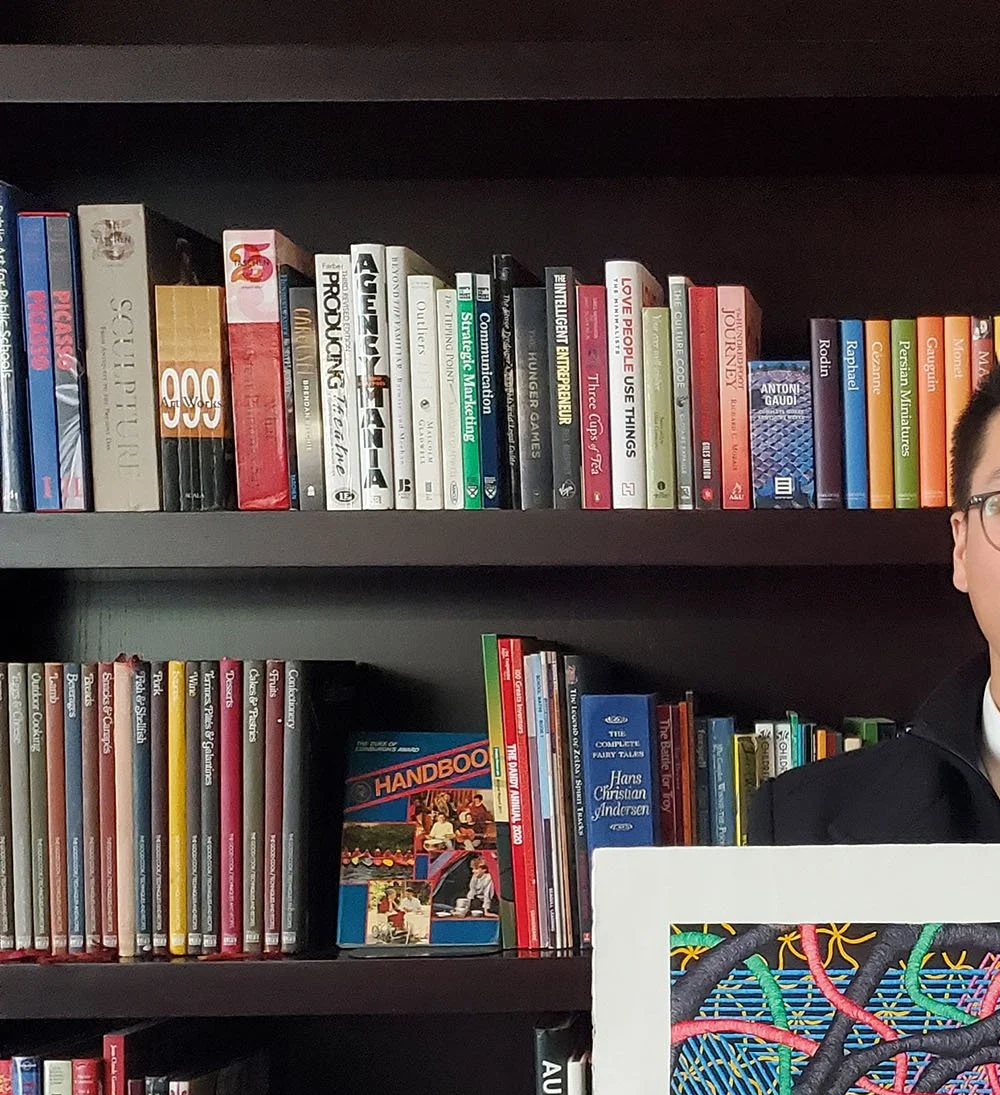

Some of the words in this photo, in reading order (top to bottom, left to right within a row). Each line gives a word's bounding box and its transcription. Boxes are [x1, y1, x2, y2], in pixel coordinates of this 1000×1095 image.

[554, 284, 570, 345] INTELLIGENT
[621, 278, 632, 315] LOVE
[26, 290, 50, 371] PICASSO
[52, 290, 75, 371] PICASSO
[323, 271, 342, 391] PRODUCING
[416, 300, 429, 356] Outliers
[460, 312, 474, 372] Strategic
[622, 316, 634, 372] PEOPLE
[722, 307, 737, 391] JOURNEY
[479, 313, 494, 415] Communication
[818, 338, 832, 378] Rodin
[844, 340, 860, 391] Raphael
[899, 340, 911, 387] Persian
[924, 337, 939, 393] Gauguin
[160, 367, 222, 429] 999
[463, 374, 478, 443] Marketing
[556, 346, 573, 425] ENTREPRENEUR
[623, 375, 635, 403] USE
[761, 383, 800, 394] ANTONI
[624, 406, 636, 458] THINGS
[900, 389, 912, 457] Miniatures
[153, 671, 163, 696] Pork
[225, 670, 234, 708] Desserts
[595, 740, 641, 748] COMPLETE
[659, 719, 671, 740] The
[375, 747, 490, 797] HANDBOO
[508, 761, 519, 788] DANDY
[610, 770, 642, 789] Hans
[660, 742, 672, 771] Battle
[511, 790, 522, 823] ANNUAL
[591, 801, 650, 821] Andersen
[594, 785, 646, 801] Christian
[662, 793, 674, 813] Troy
[513, 825, 523, 845] 2020
